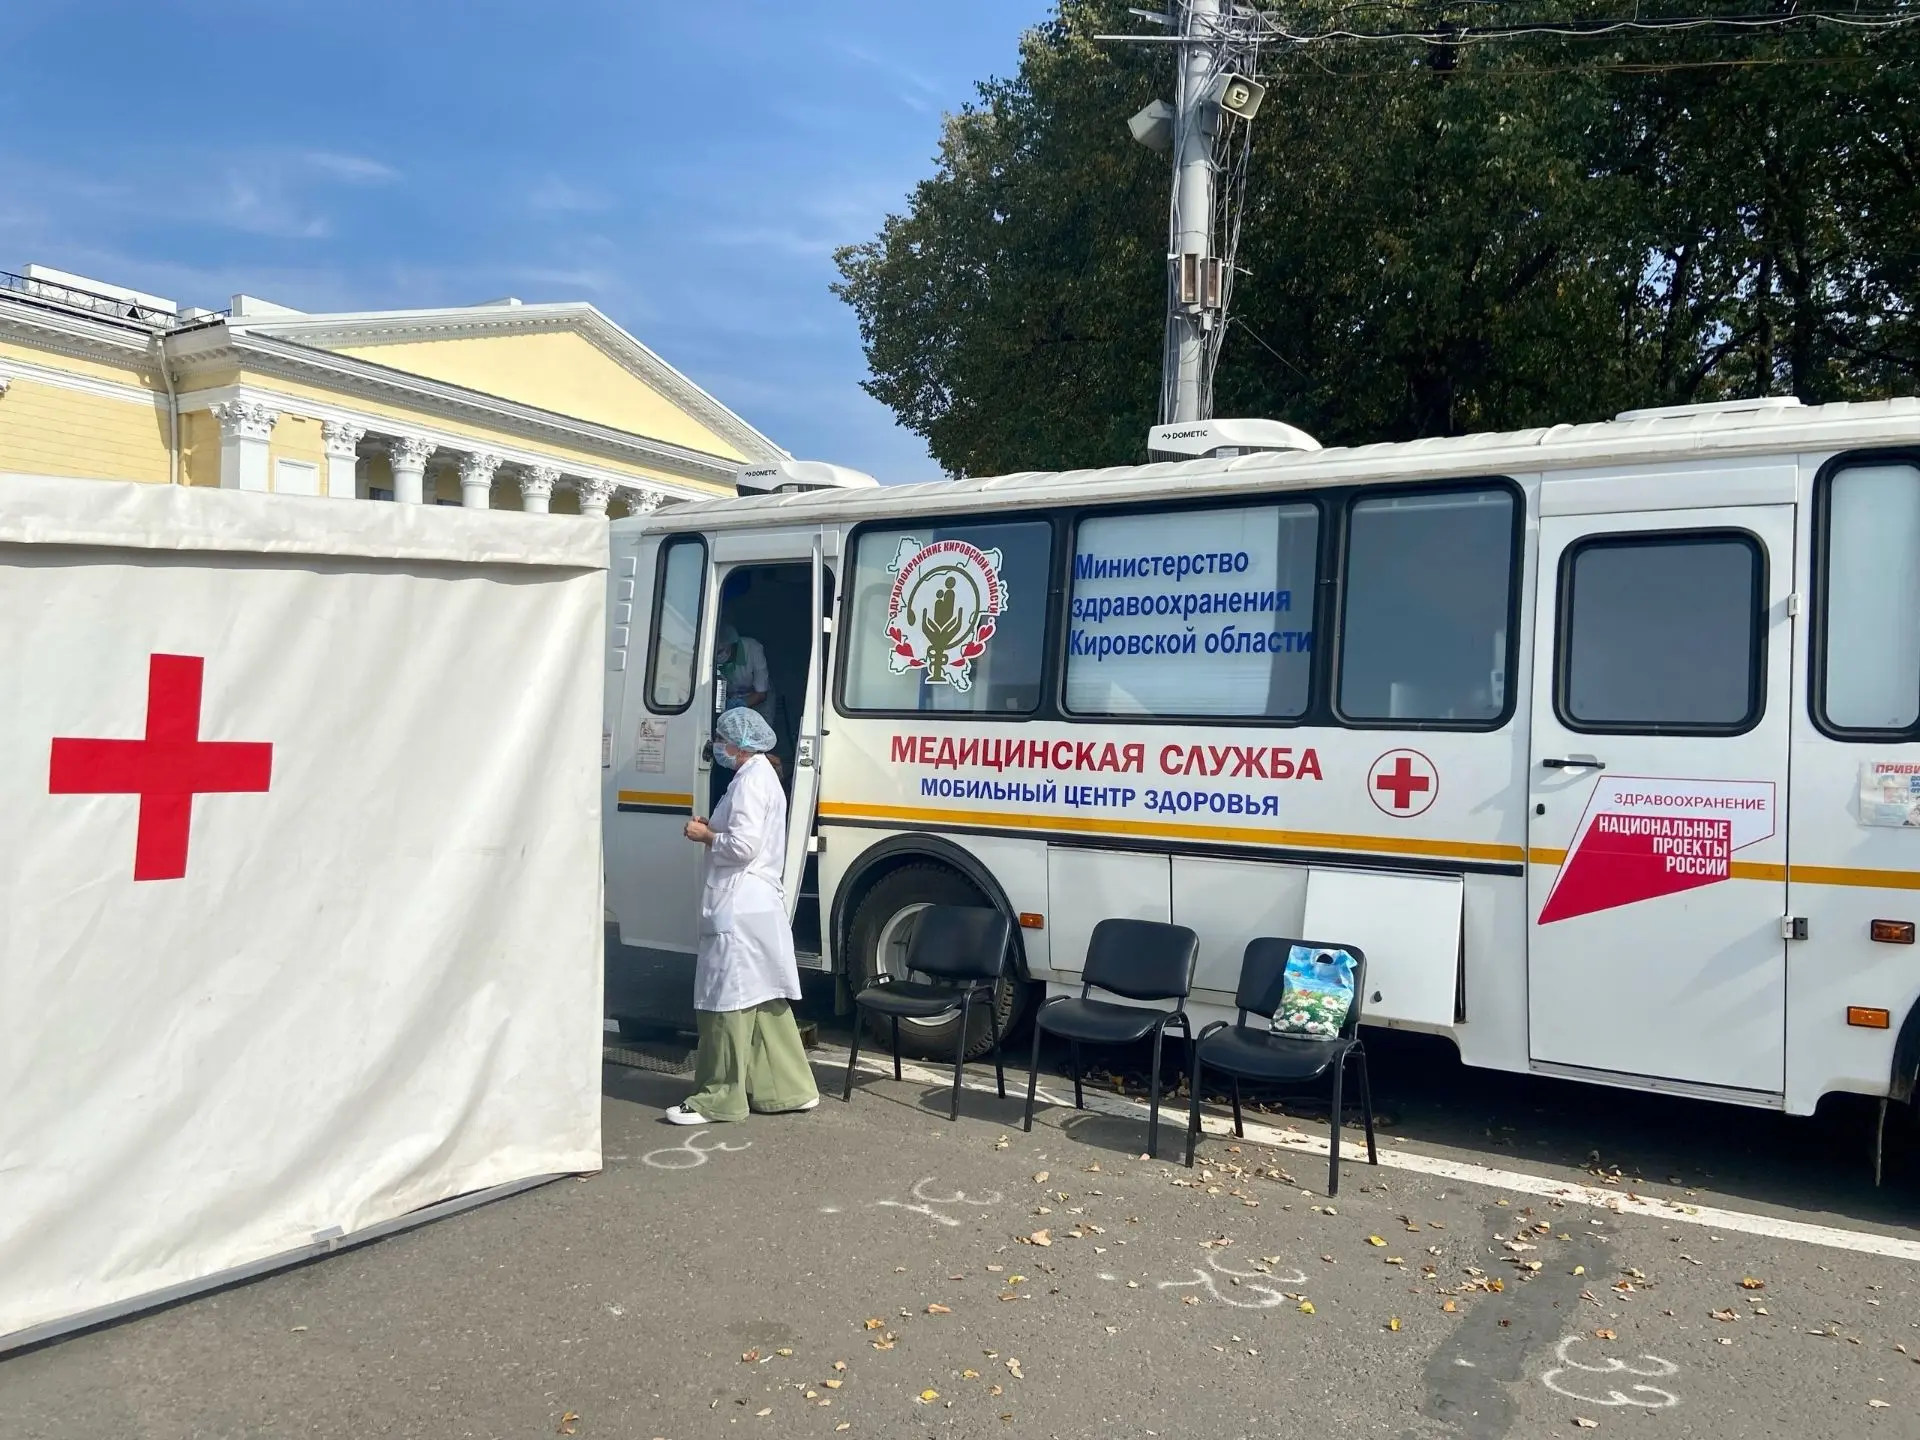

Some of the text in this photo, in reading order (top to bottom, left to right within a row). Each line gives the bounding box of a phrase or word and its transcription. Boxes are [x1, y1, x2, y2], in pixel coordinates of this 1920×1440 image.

[1172, 430, 1208, 439] DOMETIC
[889, 541, 999, 618] ЗДРАВООХРАНЕНИЕ КИРОВСКОЙ ОБЛАСТИ
[1075, 551, 1249, 582] Министерство
[1072, 590, 1292, 623] здравоохранения
[1070, 625, 1313, 662] Кировской области
[891, 735, 1323, 781] МЕДИЦИНСКАЯ СЛУЖБА
[921, 778, 1279, 816] МОБИЛЬНЫЙ ЦЕНТР ЗДОРОВЬЯ
[1614, 793, 1766, 811] ЗДРАВООХРАНЕНИЕ
[1599, 816, 1728, 840] НАЦИОНАЛЬНЫЕ
[1653, 837, 1728, 858] ПРОЕКТЫ
[1666, 855, 1728, 876] РОССИИ
